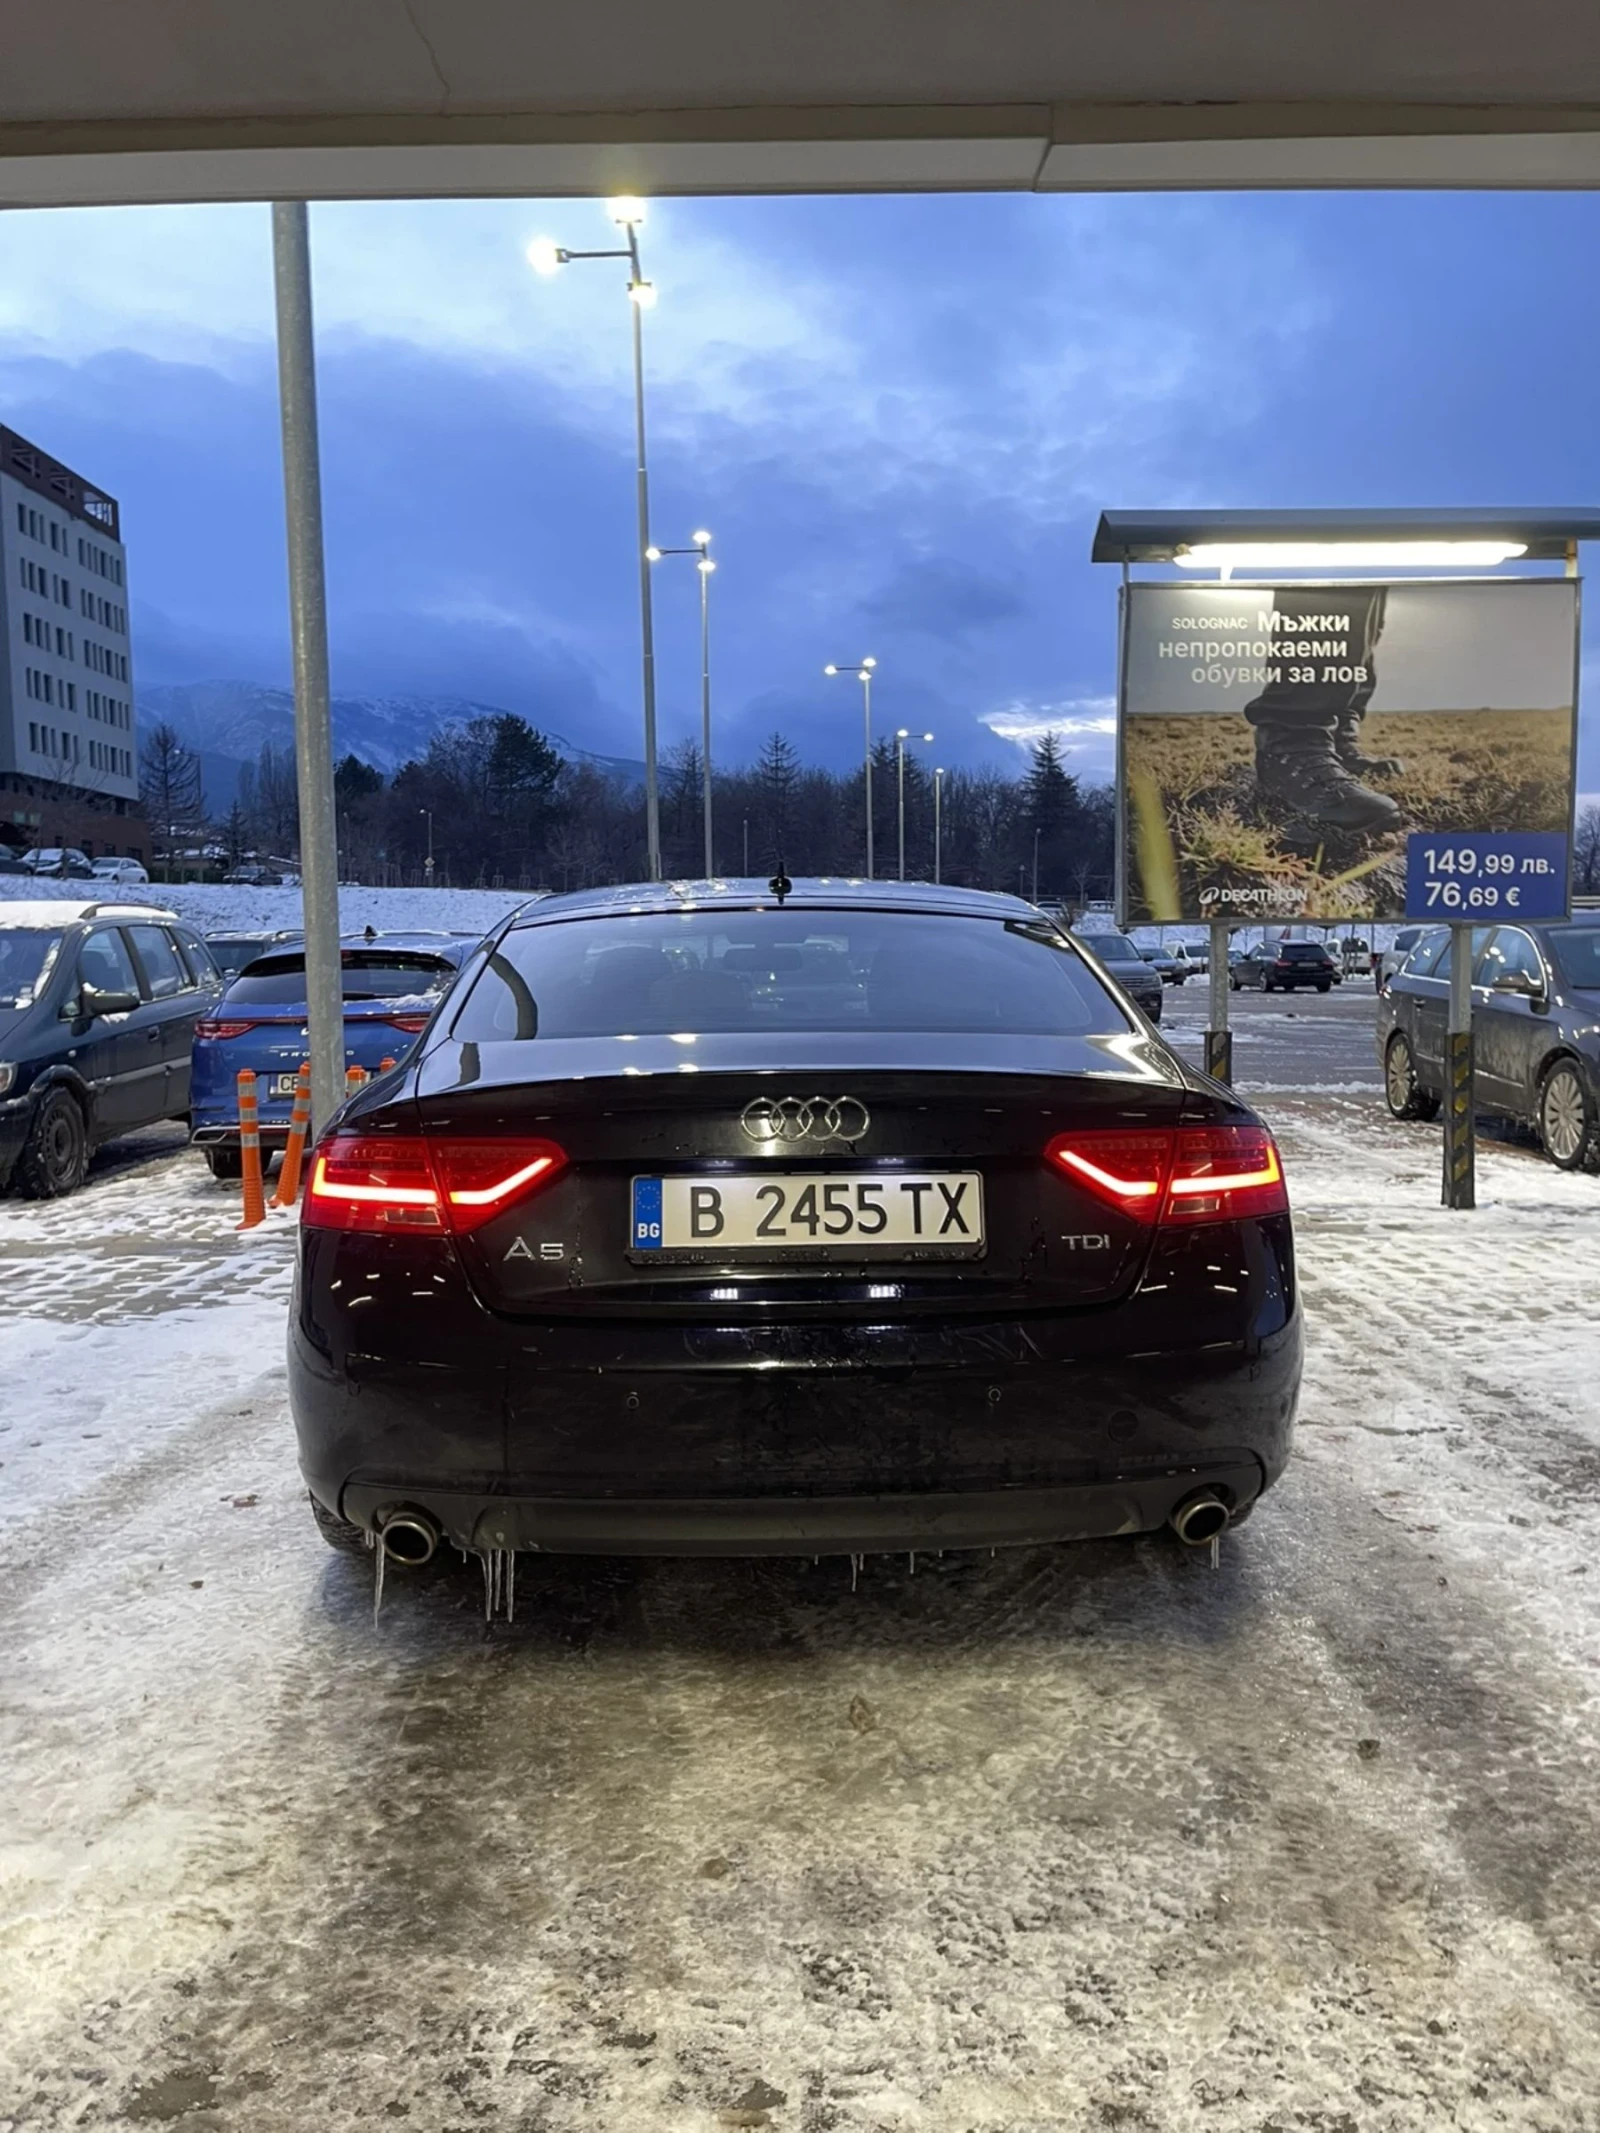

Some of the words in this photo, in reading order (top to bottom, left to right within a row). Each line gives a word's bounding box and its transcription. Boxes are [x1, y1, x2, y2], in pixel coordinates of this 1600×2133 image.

[1172, 617, 1248, 630] SOLOGNAC
[1257, 611, 1350, 632] Мъжки
[1158, 640, 1347, 662] непропокаеми
[1191, 663, 1281, 688] обувки
[1288, 667, 1316, 683] за
[1321, 666, 1368, 683] лов
[1424, 849, 1515, 878] 149,99
[1520, 858, 1556, 874] лв.
[1221, 888, 1307, 902] DECATHLON
[1424, 881, 1499, 911] 76,69
[1505, 886, 1520, 907] €
[691, 1186, 724, 1238] B
[756, 1183, 887, 1237] 2455
[900, 1182, 970, 1234] TX
[637, 1222, 660, 1238] BG
[503, 1236, 564, 1261] A5
[1061, 1234, 1110, 1250] TDI
